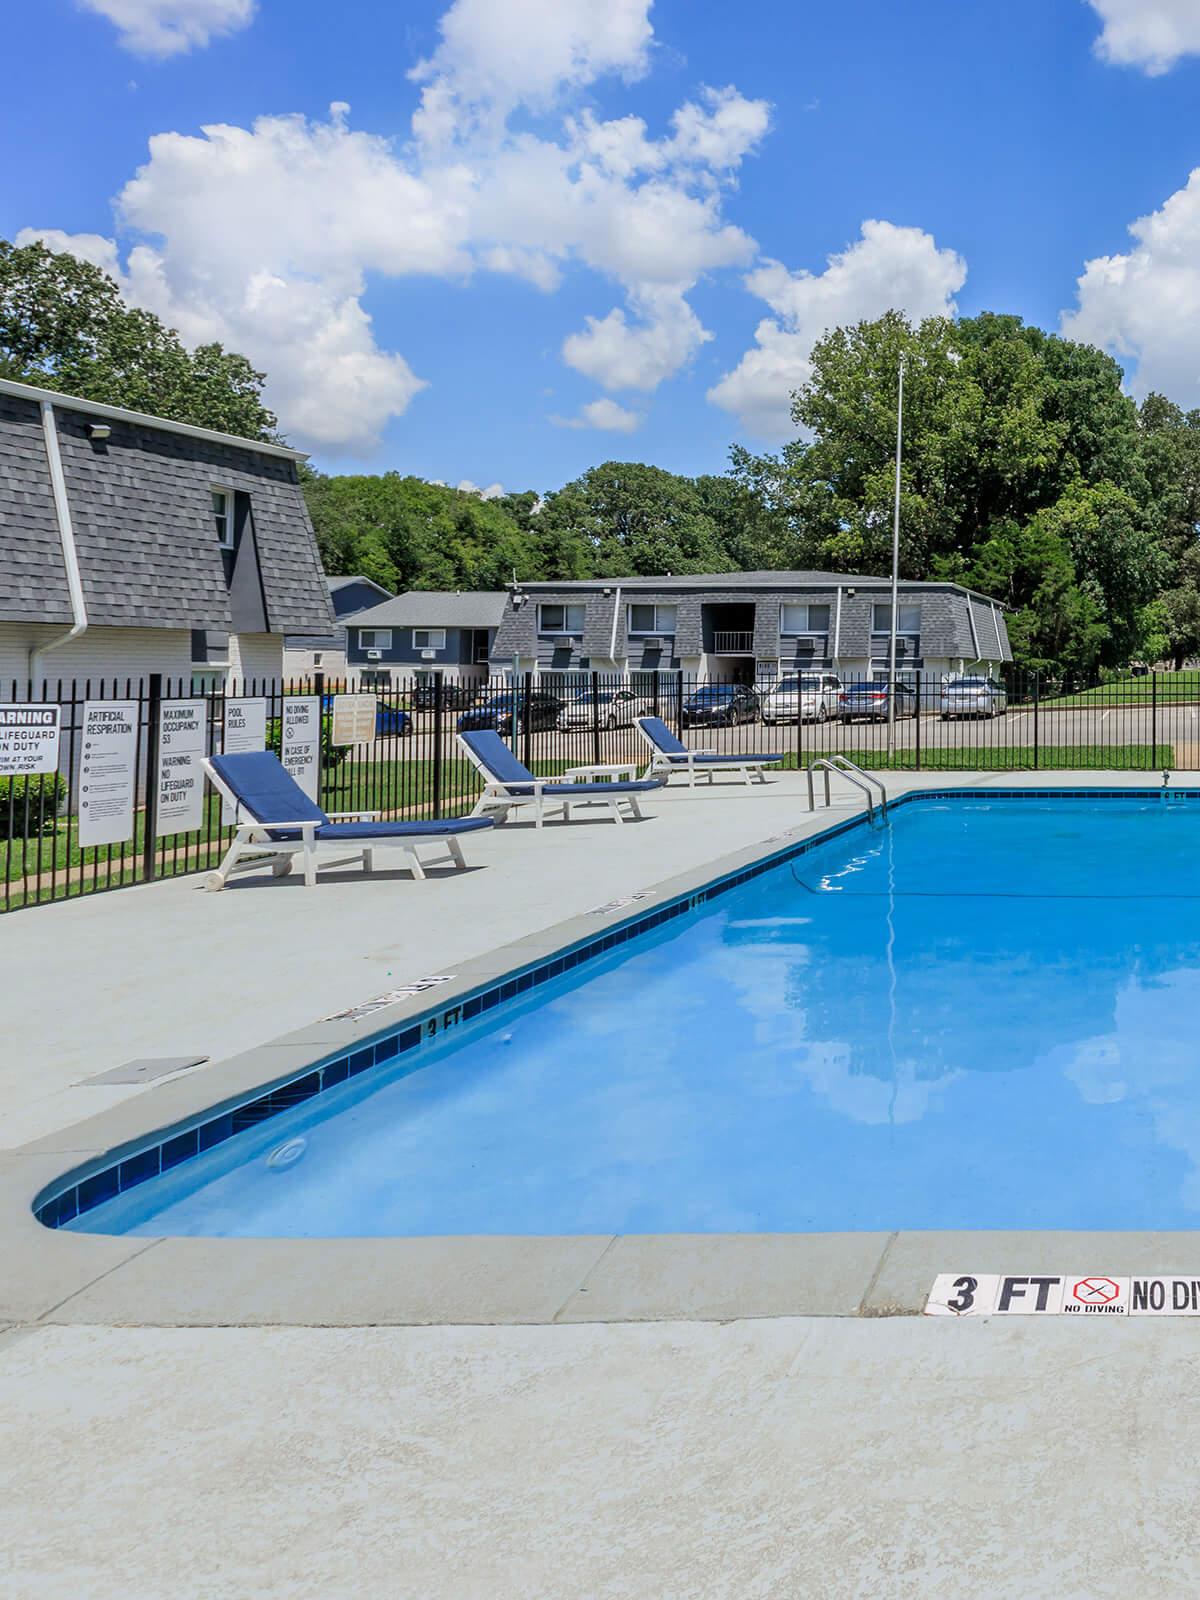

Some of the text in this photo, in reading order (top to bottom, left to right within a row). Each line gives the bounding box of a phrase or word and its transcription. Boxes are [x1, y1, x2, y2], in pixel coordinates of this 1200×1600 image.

[0, 711, 53, 724] ARNING
[87, 711, 125, 722] ARTIFICIAL
[163, 709, 194, 720] MAXIMUM
[228, 707, 242, 717] POOL
[228, 718, 246, 728] RULES
[286, 715, 309, 725] ALLOWED
[87, 723, 132, 735] RESPIRATION
[162, 720, 199, 732] OCCUPANCY
[13, 742, 40, 751] DUTY
[161, 769, 171, 779] NO
[160, 778, 194, 791] LIFEGUARD
[160, 791, 186, 804] ON DUTY
[444, 1005, 461, 1030] FT
[947, 1276, 1060, 1312] 3 FT
[1132, 1280, 1165, 1310] NO
[1064, 1304, 1124, 1313] NO DIVING
